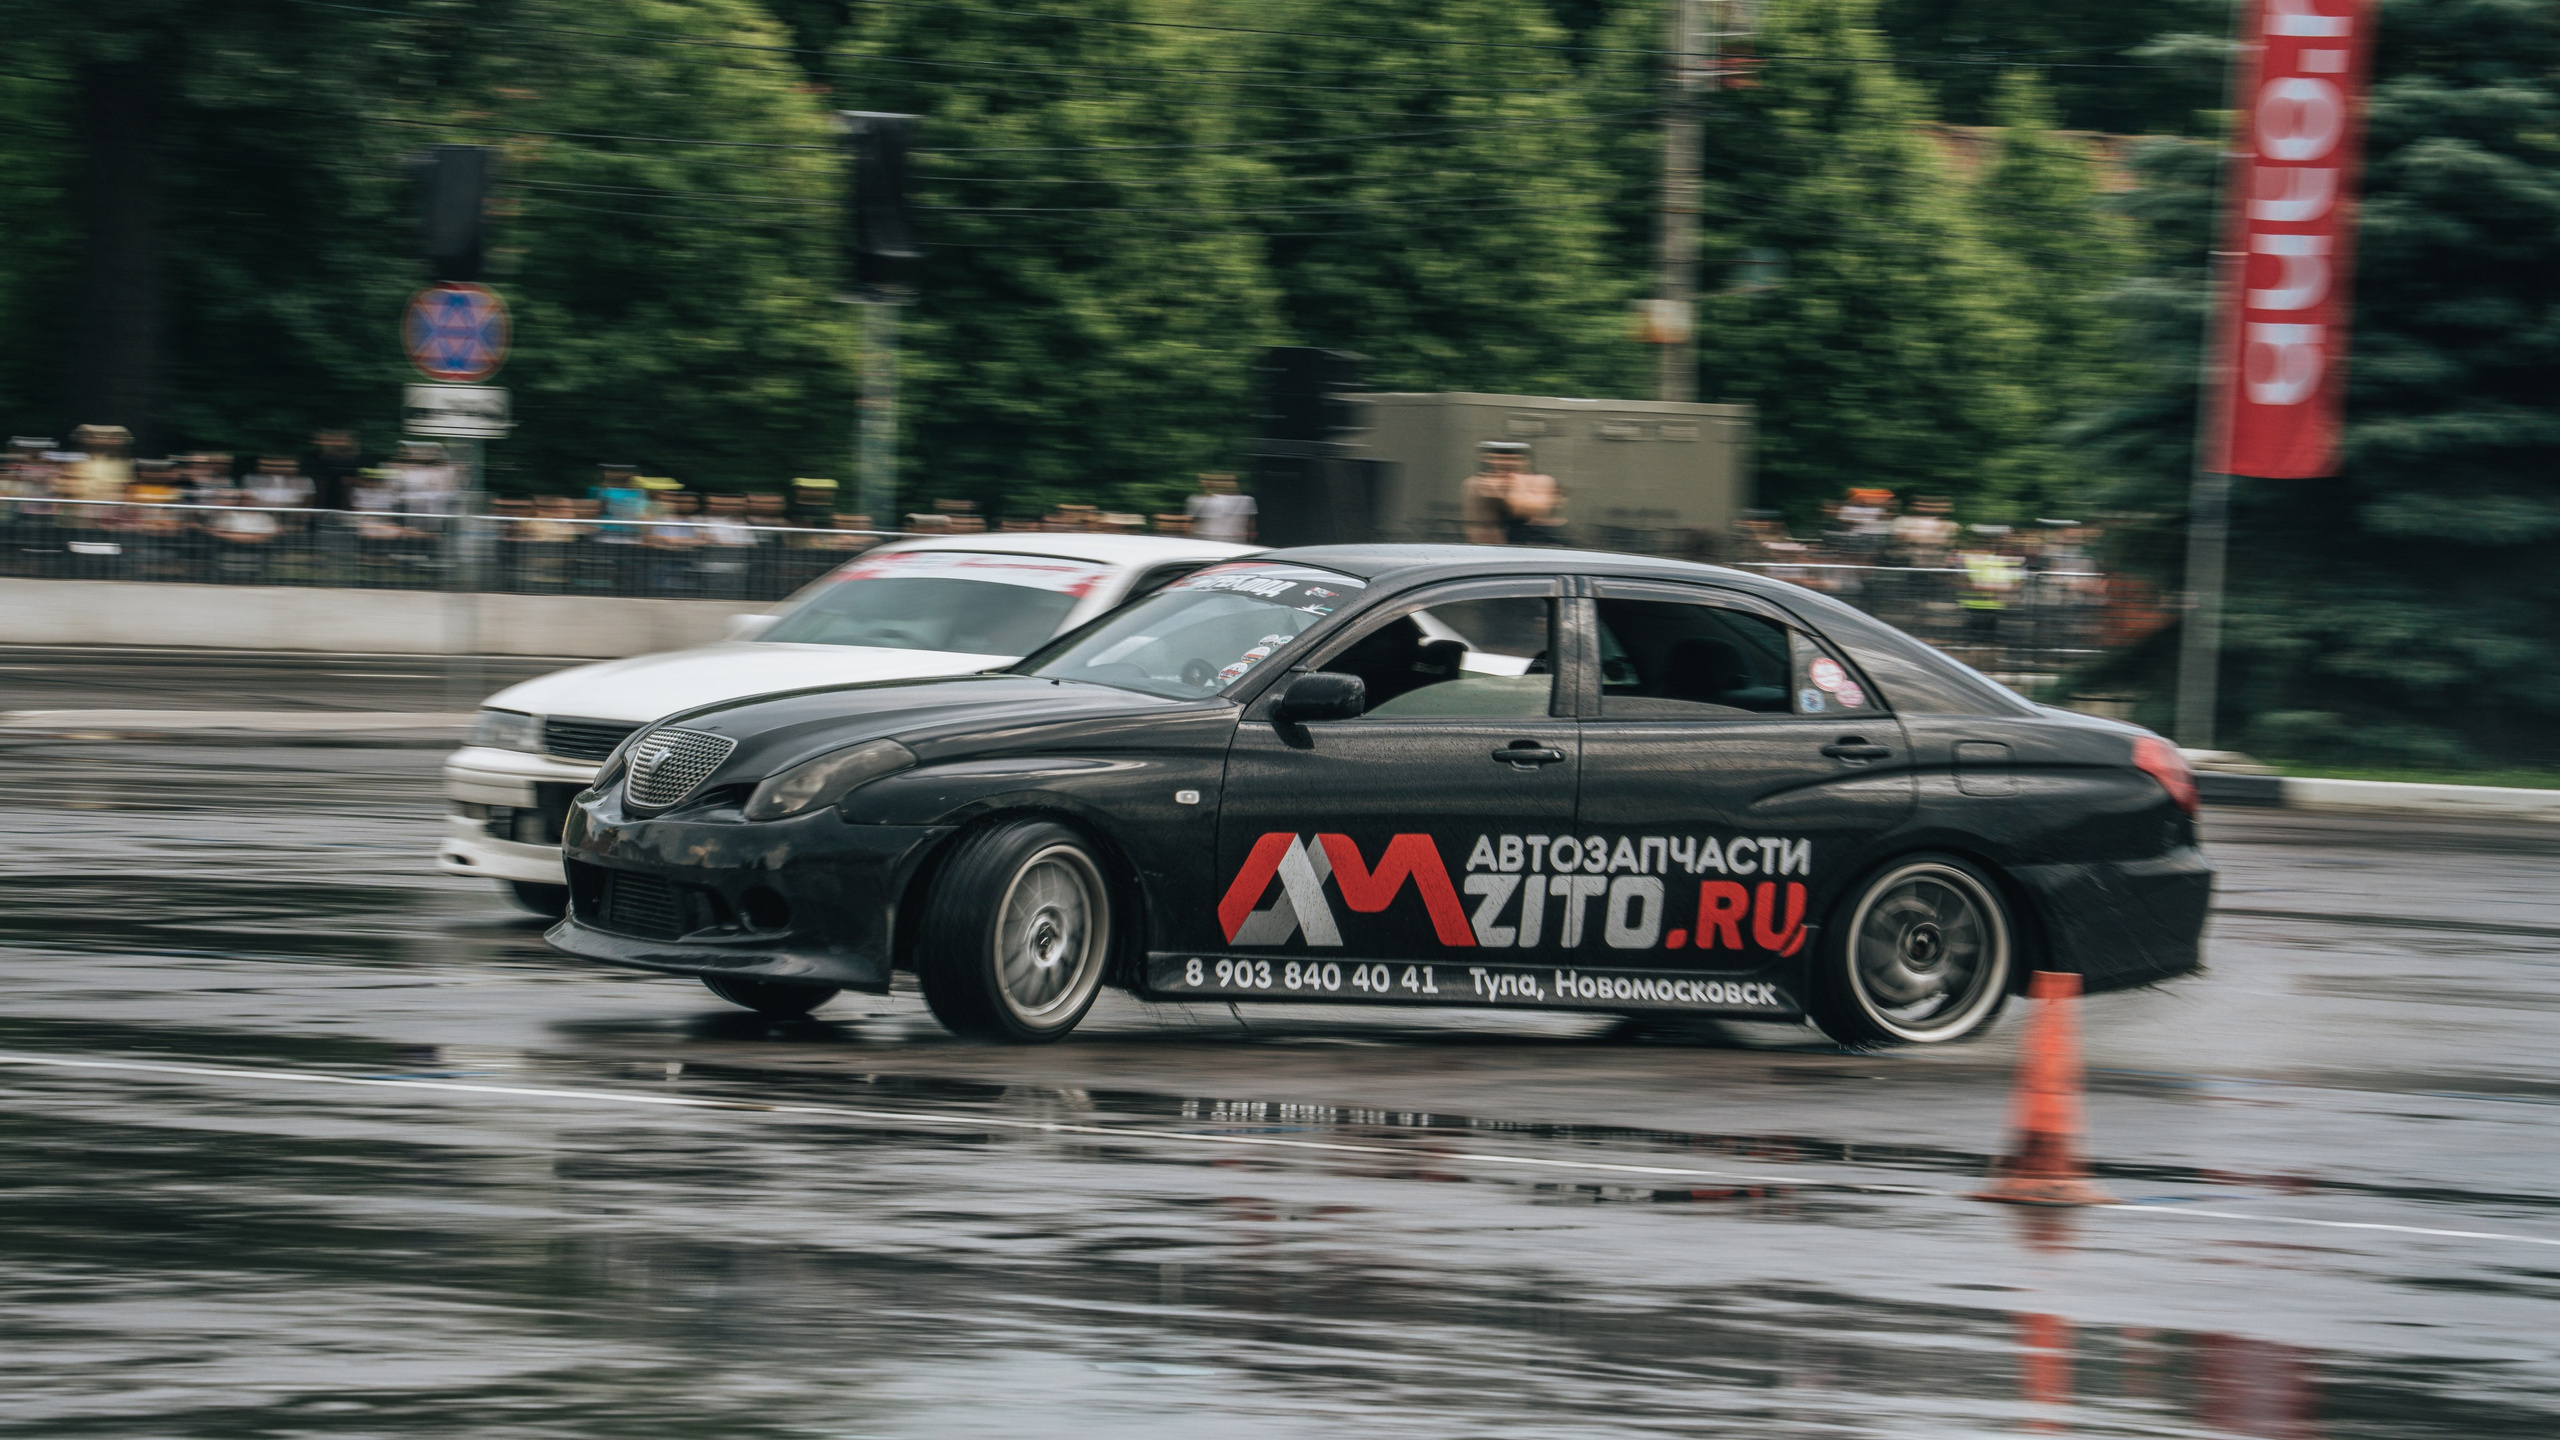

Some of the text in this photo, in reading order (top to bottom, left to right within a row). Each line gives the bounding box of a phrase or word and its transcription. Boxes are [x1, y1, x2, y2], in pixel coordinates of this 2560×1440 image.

[1466, 834, 1811, 876] АВТОЗАПЧАСТИ
[1185, 958, 1439, 994] 8 903 840 40 41
[1469, 967, 1778, 1006] Тула, Новомосковск
